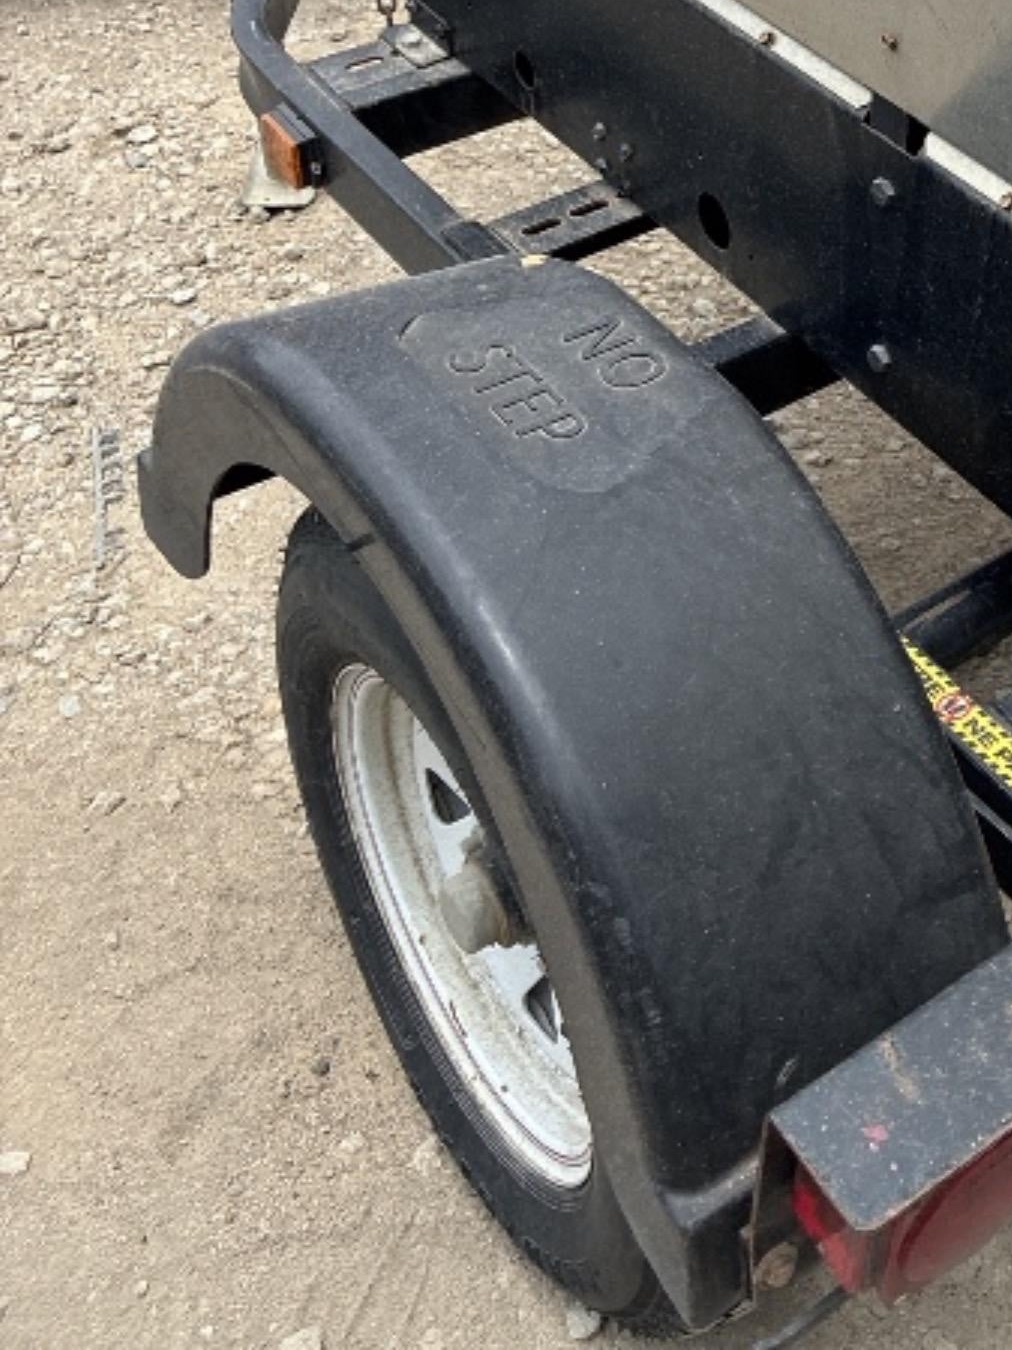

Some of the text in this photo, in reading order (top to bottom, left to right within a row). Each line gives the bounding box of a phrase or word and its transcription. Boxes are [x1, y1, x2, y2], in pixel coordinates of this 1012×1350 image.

[563, 318, 668, 390] NO
[447, 343, 589, 440] STEP
[963, 718, 999, 748] NE
